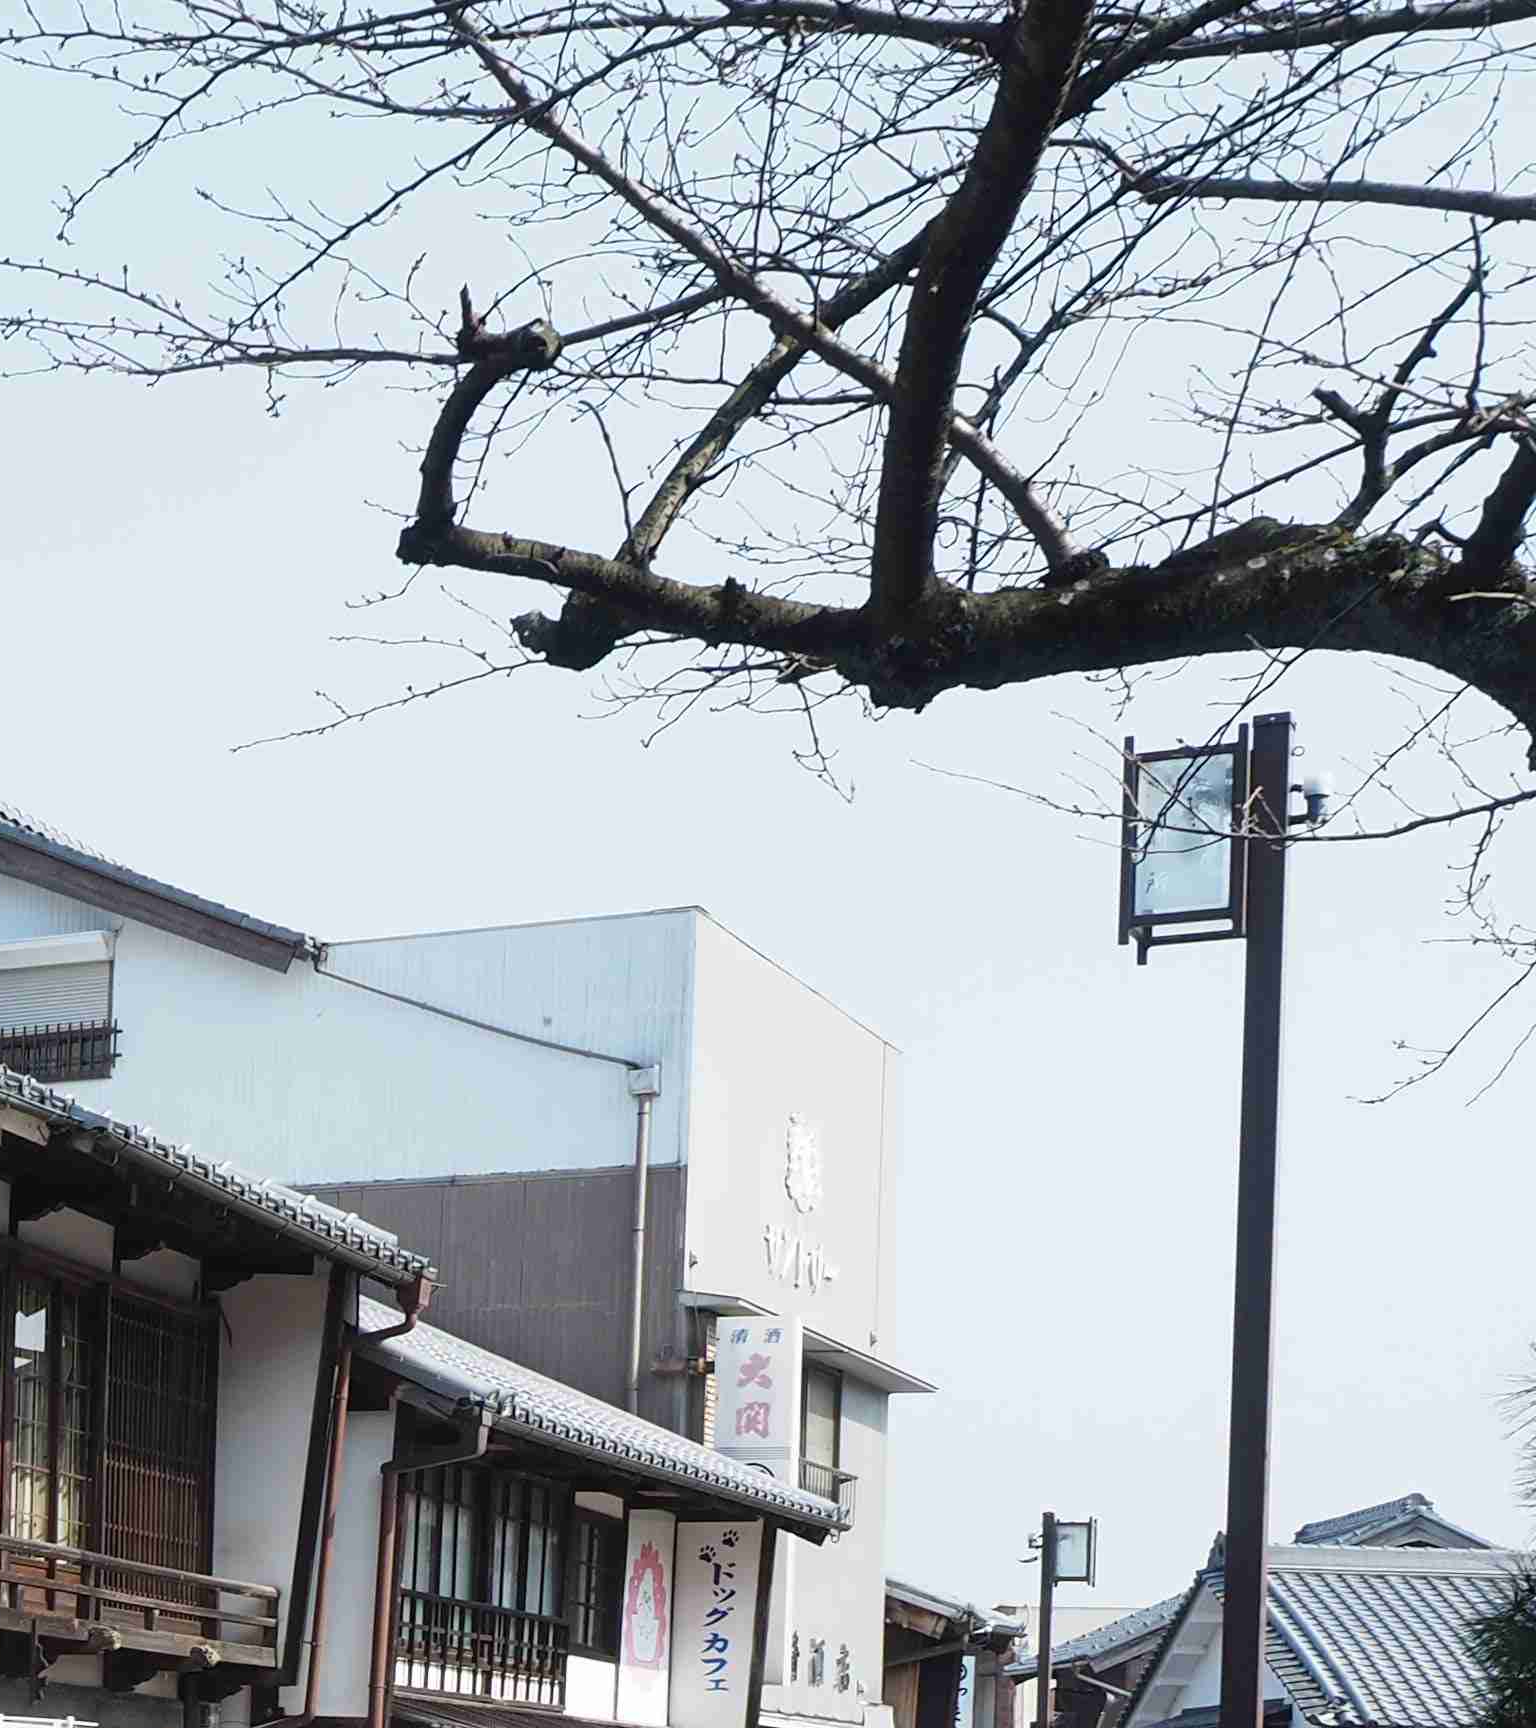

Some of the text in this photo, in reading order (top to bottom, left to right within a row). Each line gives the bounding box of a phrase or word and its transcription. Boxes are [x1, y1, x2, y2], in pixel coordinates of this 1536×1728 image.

[700, 1562, 737, 1693] ドッグカフェ
